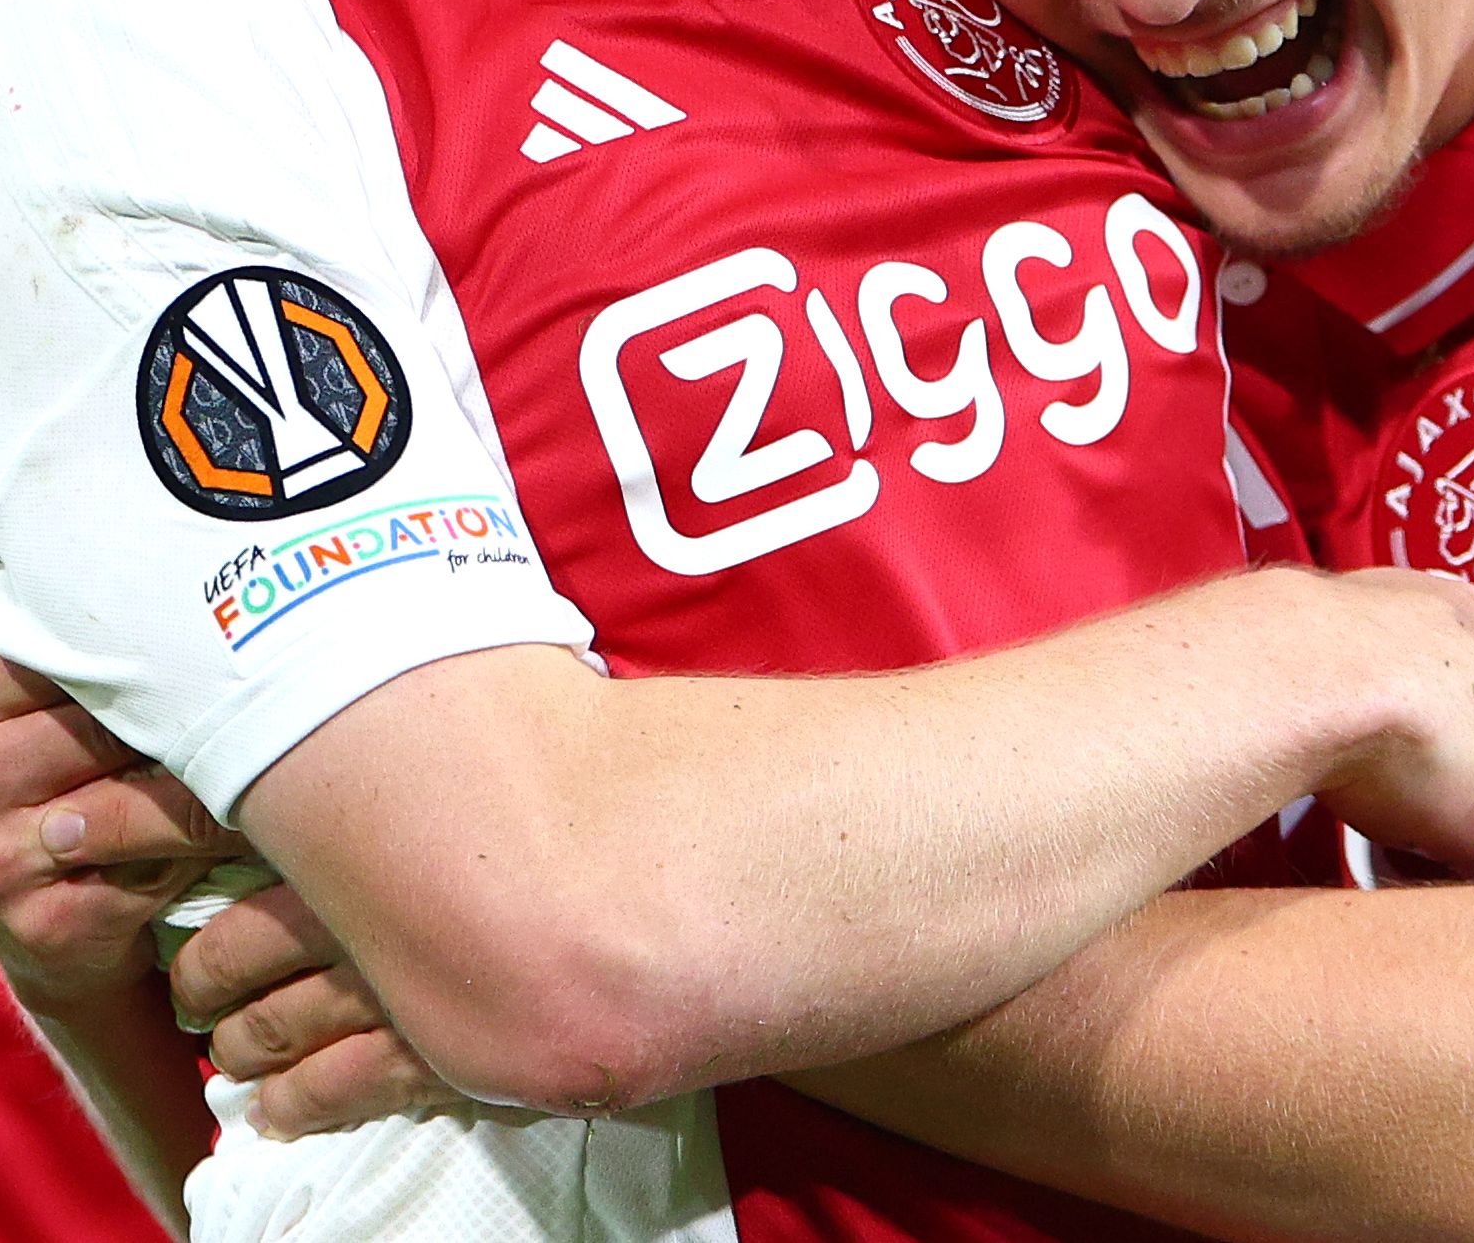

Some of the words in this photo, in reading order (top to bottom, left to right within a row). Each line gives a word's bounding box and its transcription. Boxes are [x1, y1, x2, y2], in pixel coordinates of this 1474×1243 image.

[1384, 387, 1471, 519] AJAX
[203, 544, 267, 605] UEFA
[212, 506, 519, 641] FOUNDATION
[447, 549, 470, 574] for
[476, 547, 531, 566] children
